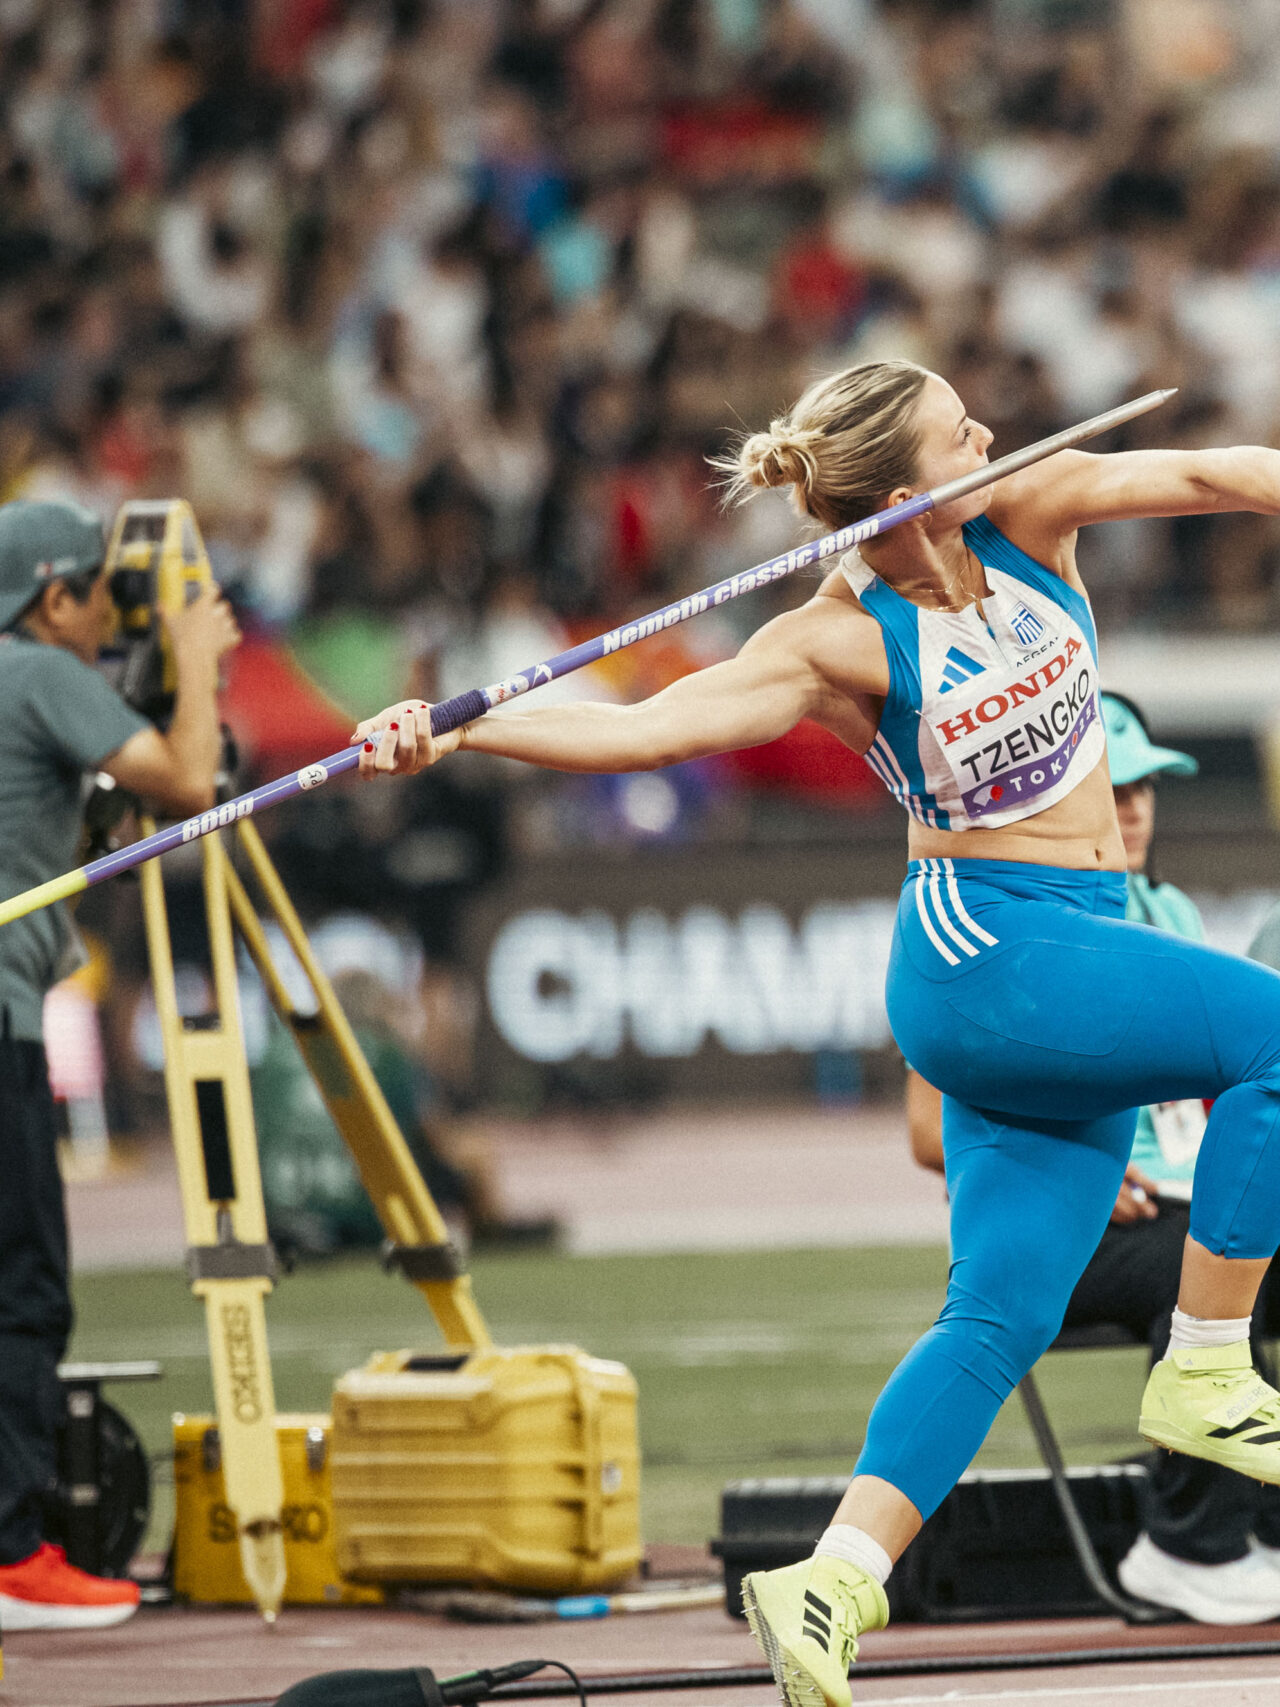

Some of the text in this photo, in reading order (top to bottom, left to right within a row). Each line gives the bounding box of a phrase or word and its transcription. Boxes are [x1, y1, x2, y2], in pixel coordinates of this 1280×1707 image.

[602, 518, 880, 656] Nemeth classic 80m
[936, 637, 1082, 745] HONDA
[960, 668, 1090, 783] TZENGKO
[182, 796, 254, 843] 600g
[221, 1304, 264, 1426] SEIKO
[208, 1503, 330, 1544] SKO
